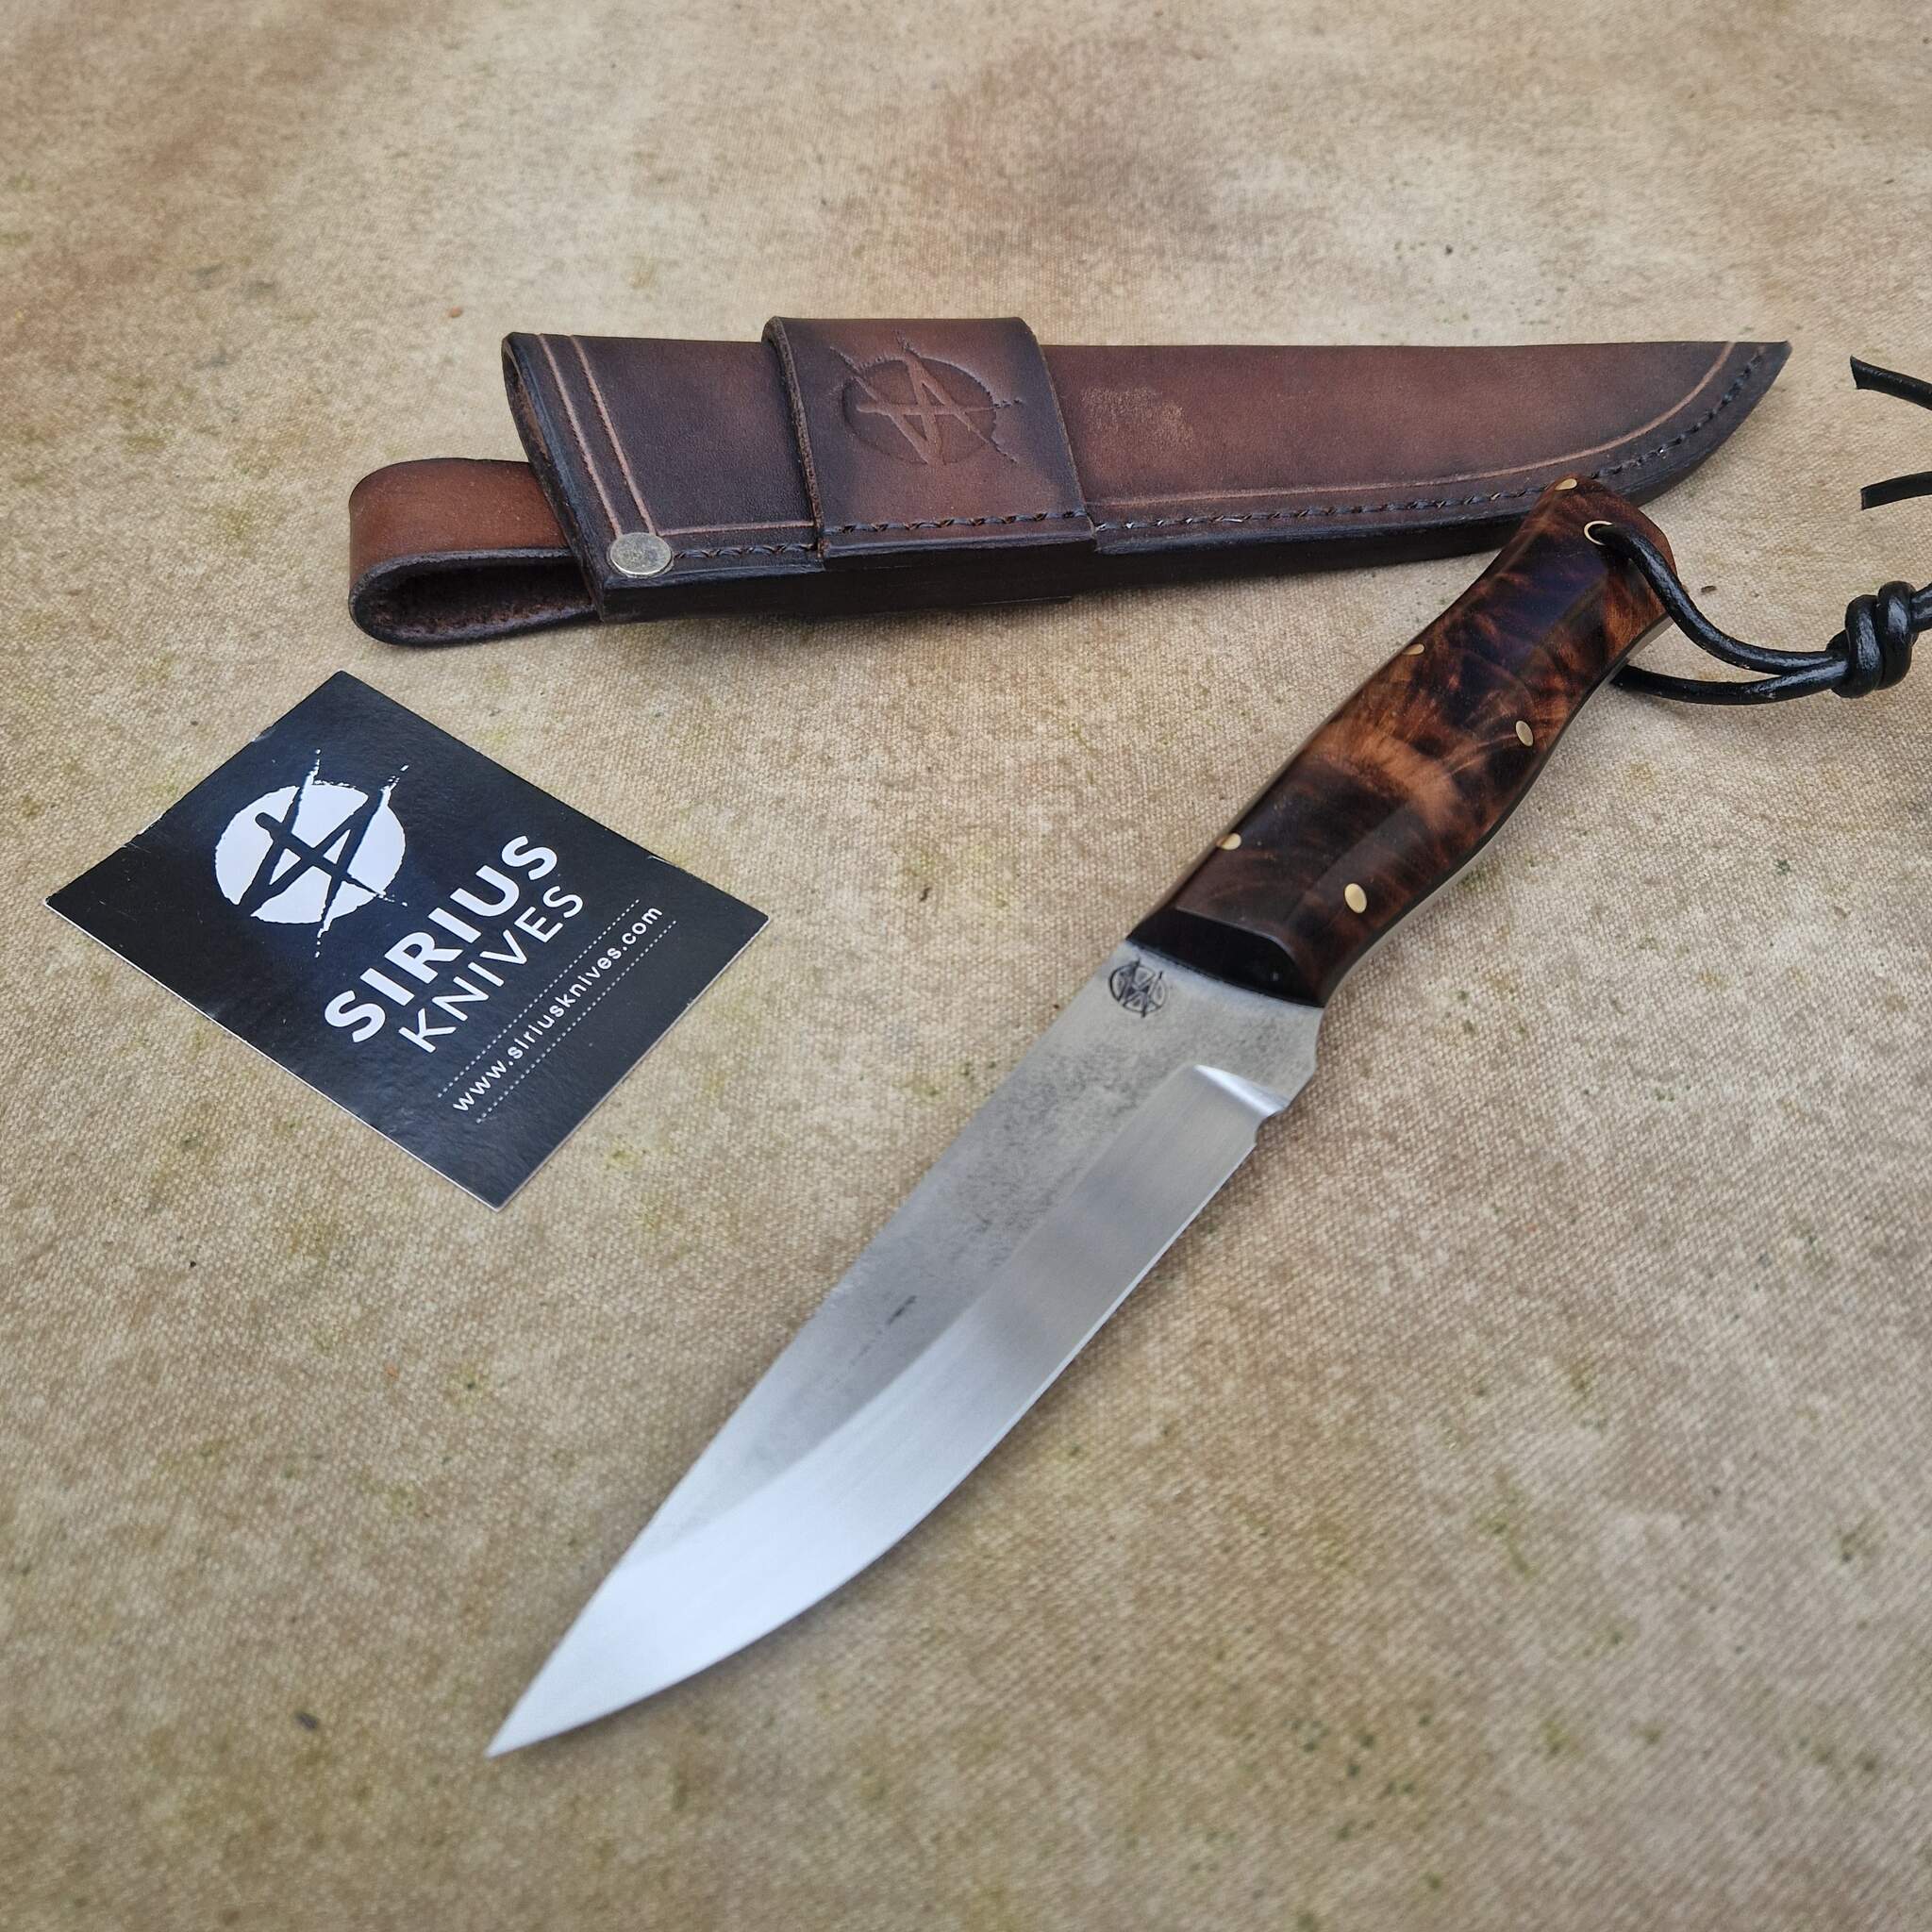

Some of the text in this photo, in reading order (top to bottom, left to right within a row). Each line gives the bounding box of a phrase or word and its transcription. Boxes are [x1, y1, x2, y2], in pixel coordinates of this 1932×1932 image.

[324, 835, 558, 1042] SIRIUS
[398, 885, 583, 1053] KNIVES
[453, 906, 662, 1112] www.siriusknives.com
